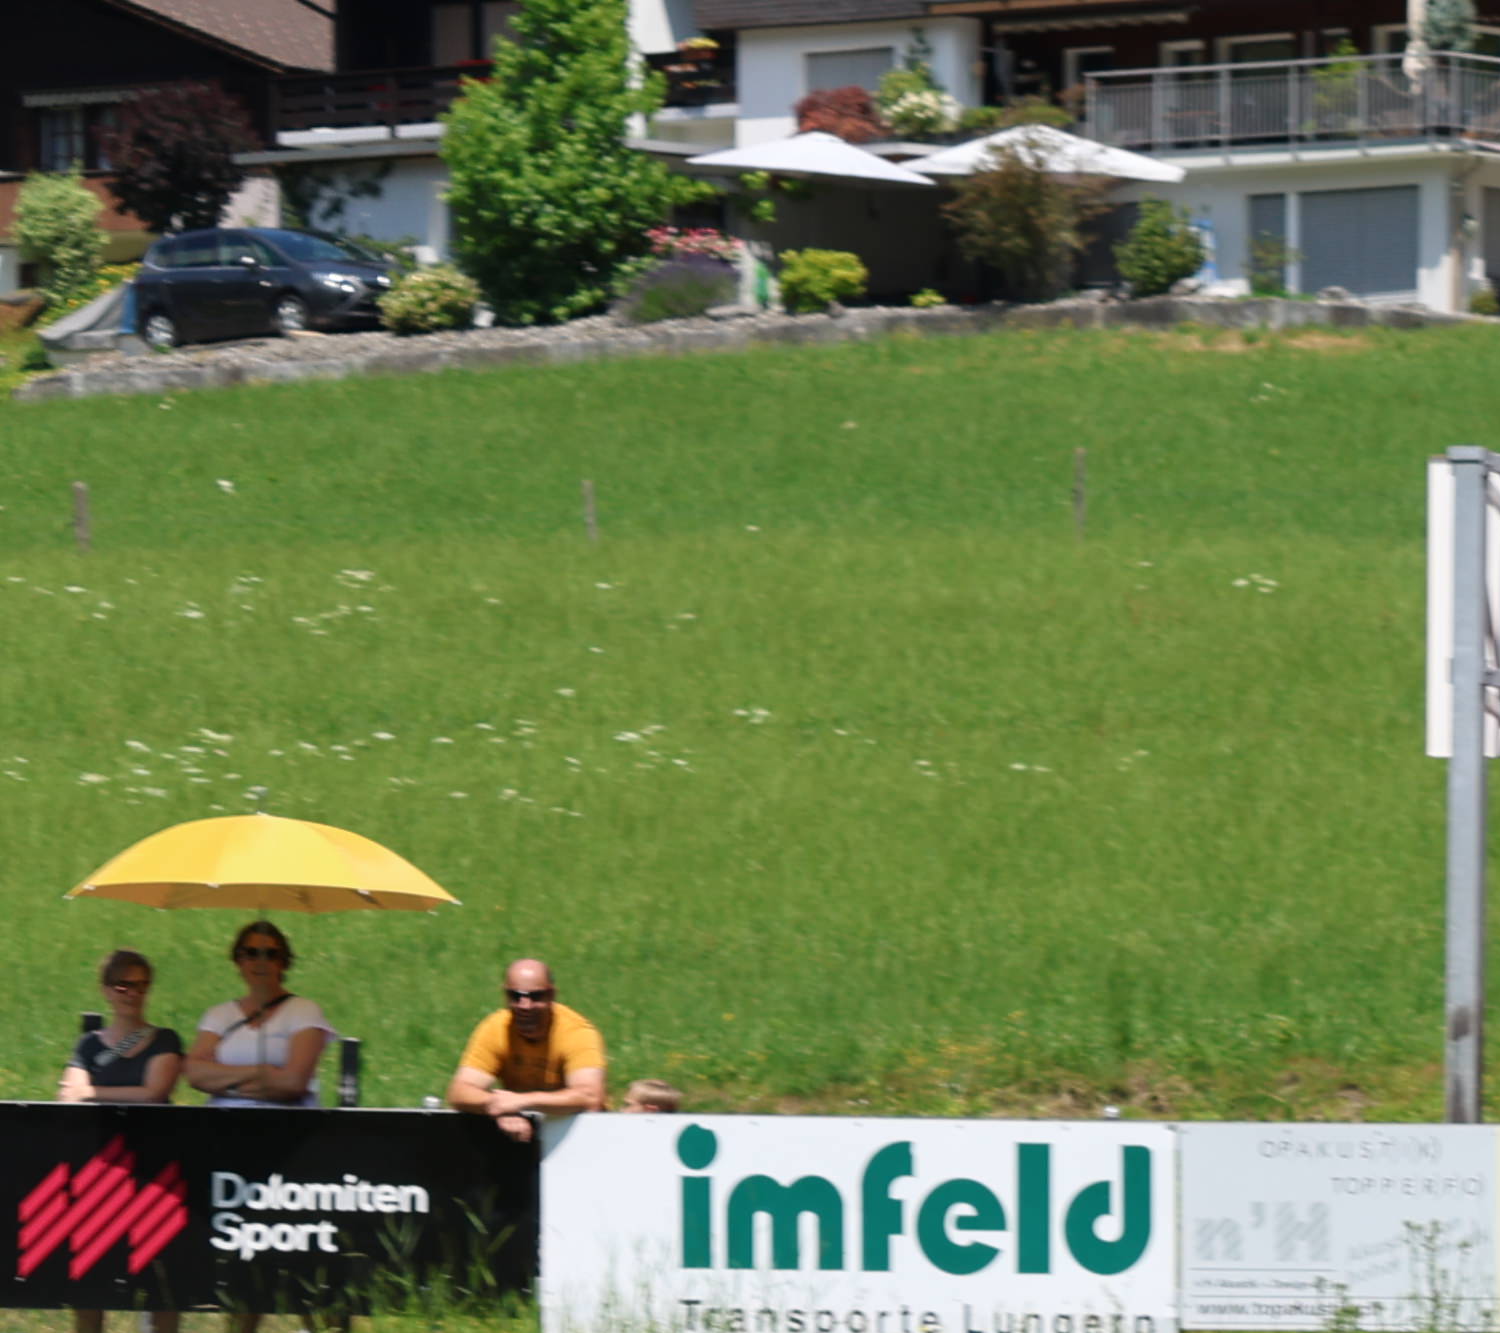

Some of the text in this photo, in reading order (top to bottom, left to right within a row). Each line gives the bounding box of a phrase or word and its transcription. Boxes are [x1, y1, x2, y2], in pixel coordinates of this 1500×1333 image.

[211, 1170, 429, 1214] Dolomiten
[676, 1123, 1153, 1275] imfeld
[210, 1212, 338, 1261] Sport
